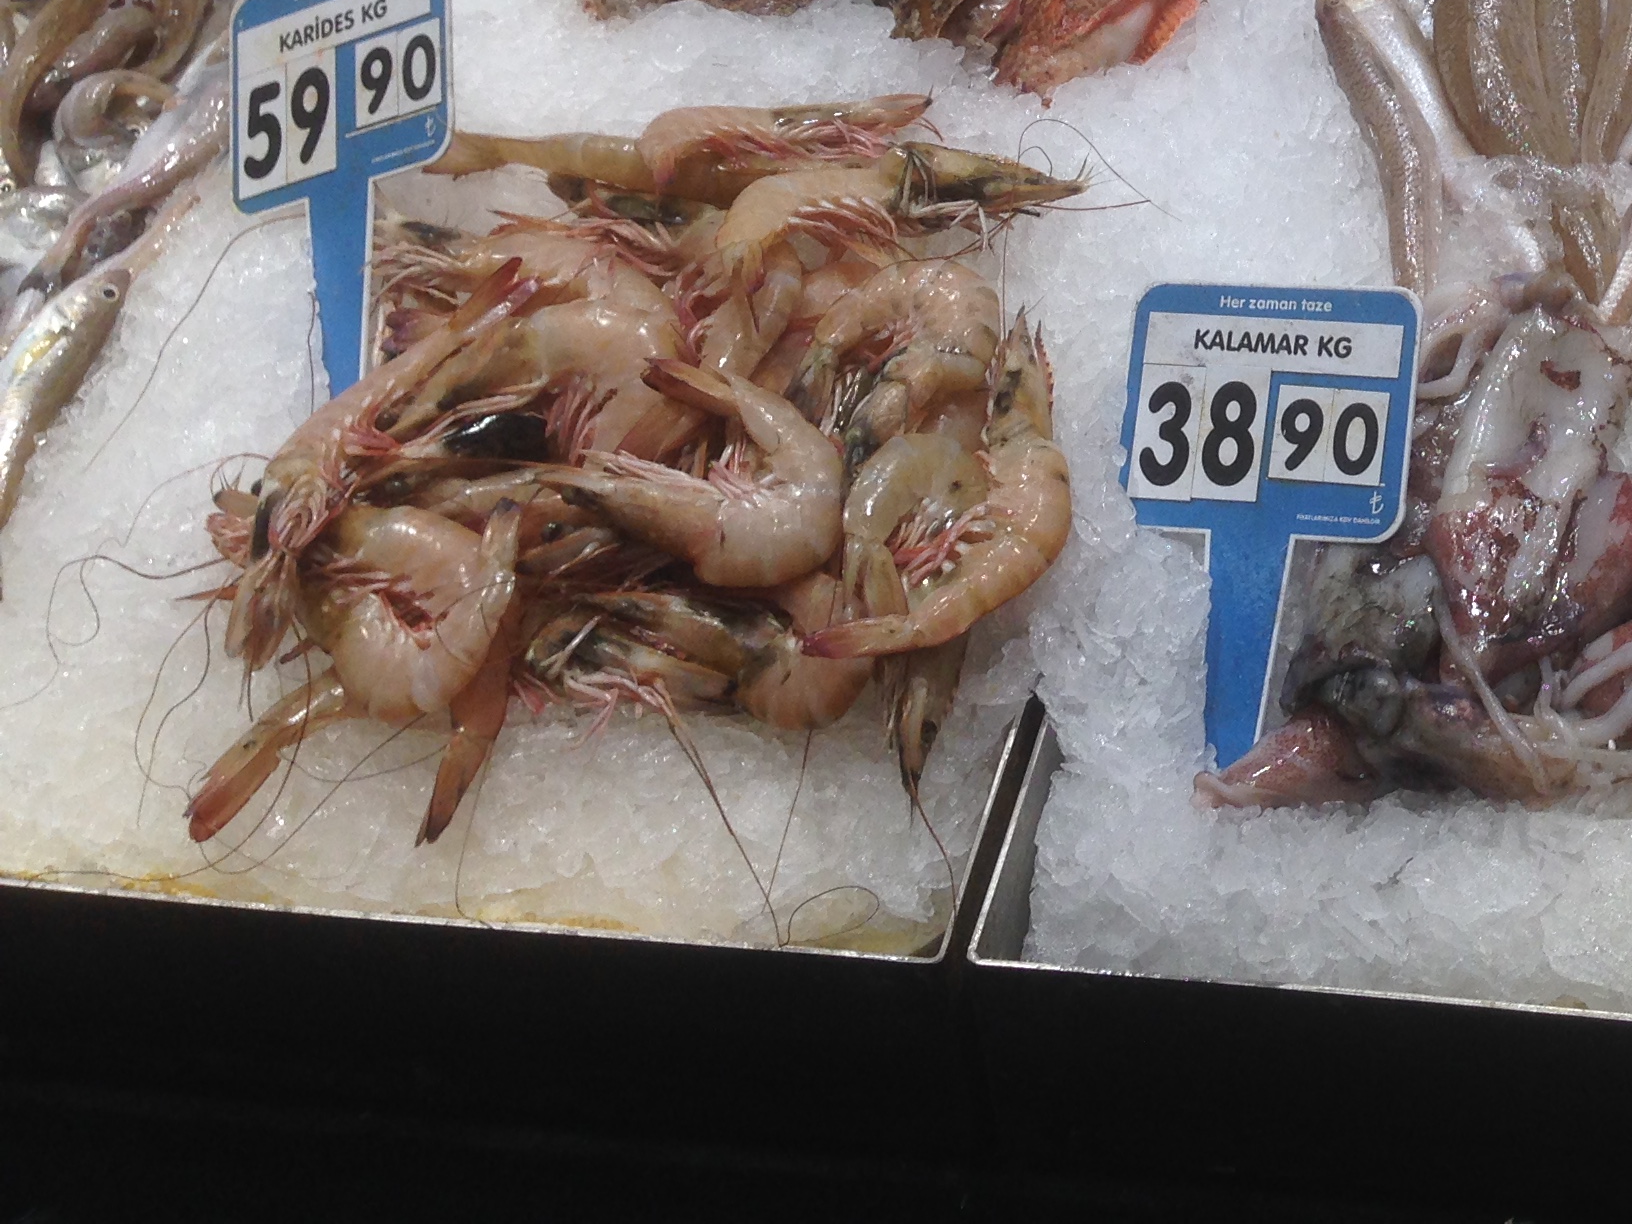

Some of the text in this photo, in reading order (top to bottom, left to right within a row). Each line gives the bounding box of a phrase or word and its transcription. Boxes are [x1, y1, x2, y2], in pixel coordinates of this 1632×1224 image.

[279, 14, 354, 53] KARİDES
[244, 34, 436, 179] 59 90
[1220, 295, 1333, 313] Her zaman taze
[1194, 328, 1353, 359] KALAMAR KG
[1139, 381, 1379, 487] 38 90
